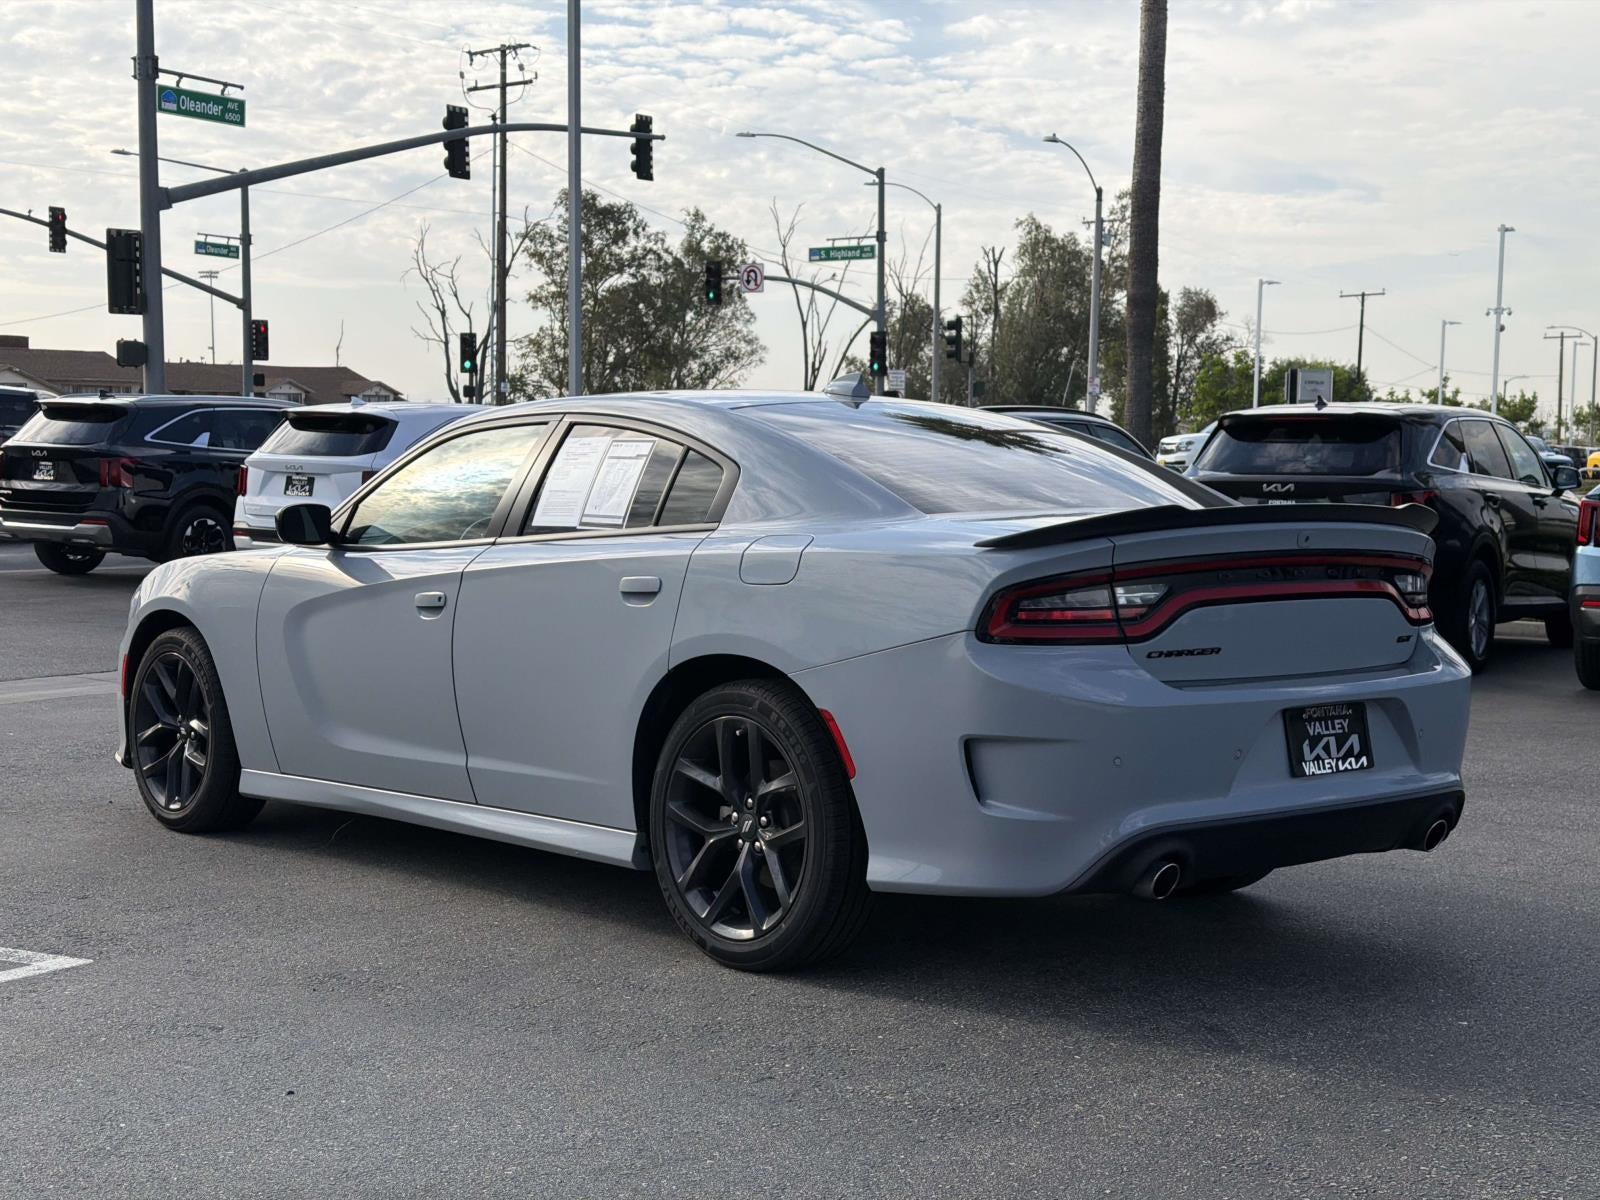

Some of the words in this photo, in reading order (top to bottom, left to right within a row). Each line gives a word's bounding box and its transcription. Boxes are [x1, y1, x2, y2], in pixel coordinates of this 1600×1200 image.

[180, 96, 223, 116] Oleander
[226, 101, 239, 111] AVE
[225, 113, 240, 122] 6500
[829, 248, 861, 260] Highland
[1262, 483, 1295, 492] KIA
[1145, 647, 1222, 659] CHARGER
[1305, 718, 1349, 737] VALLEY
[1303, 734, 1360, 760] KIA
[1302, 758, 1337, 776] VALLEY
[1337, 755, 1368, 771] KIA
